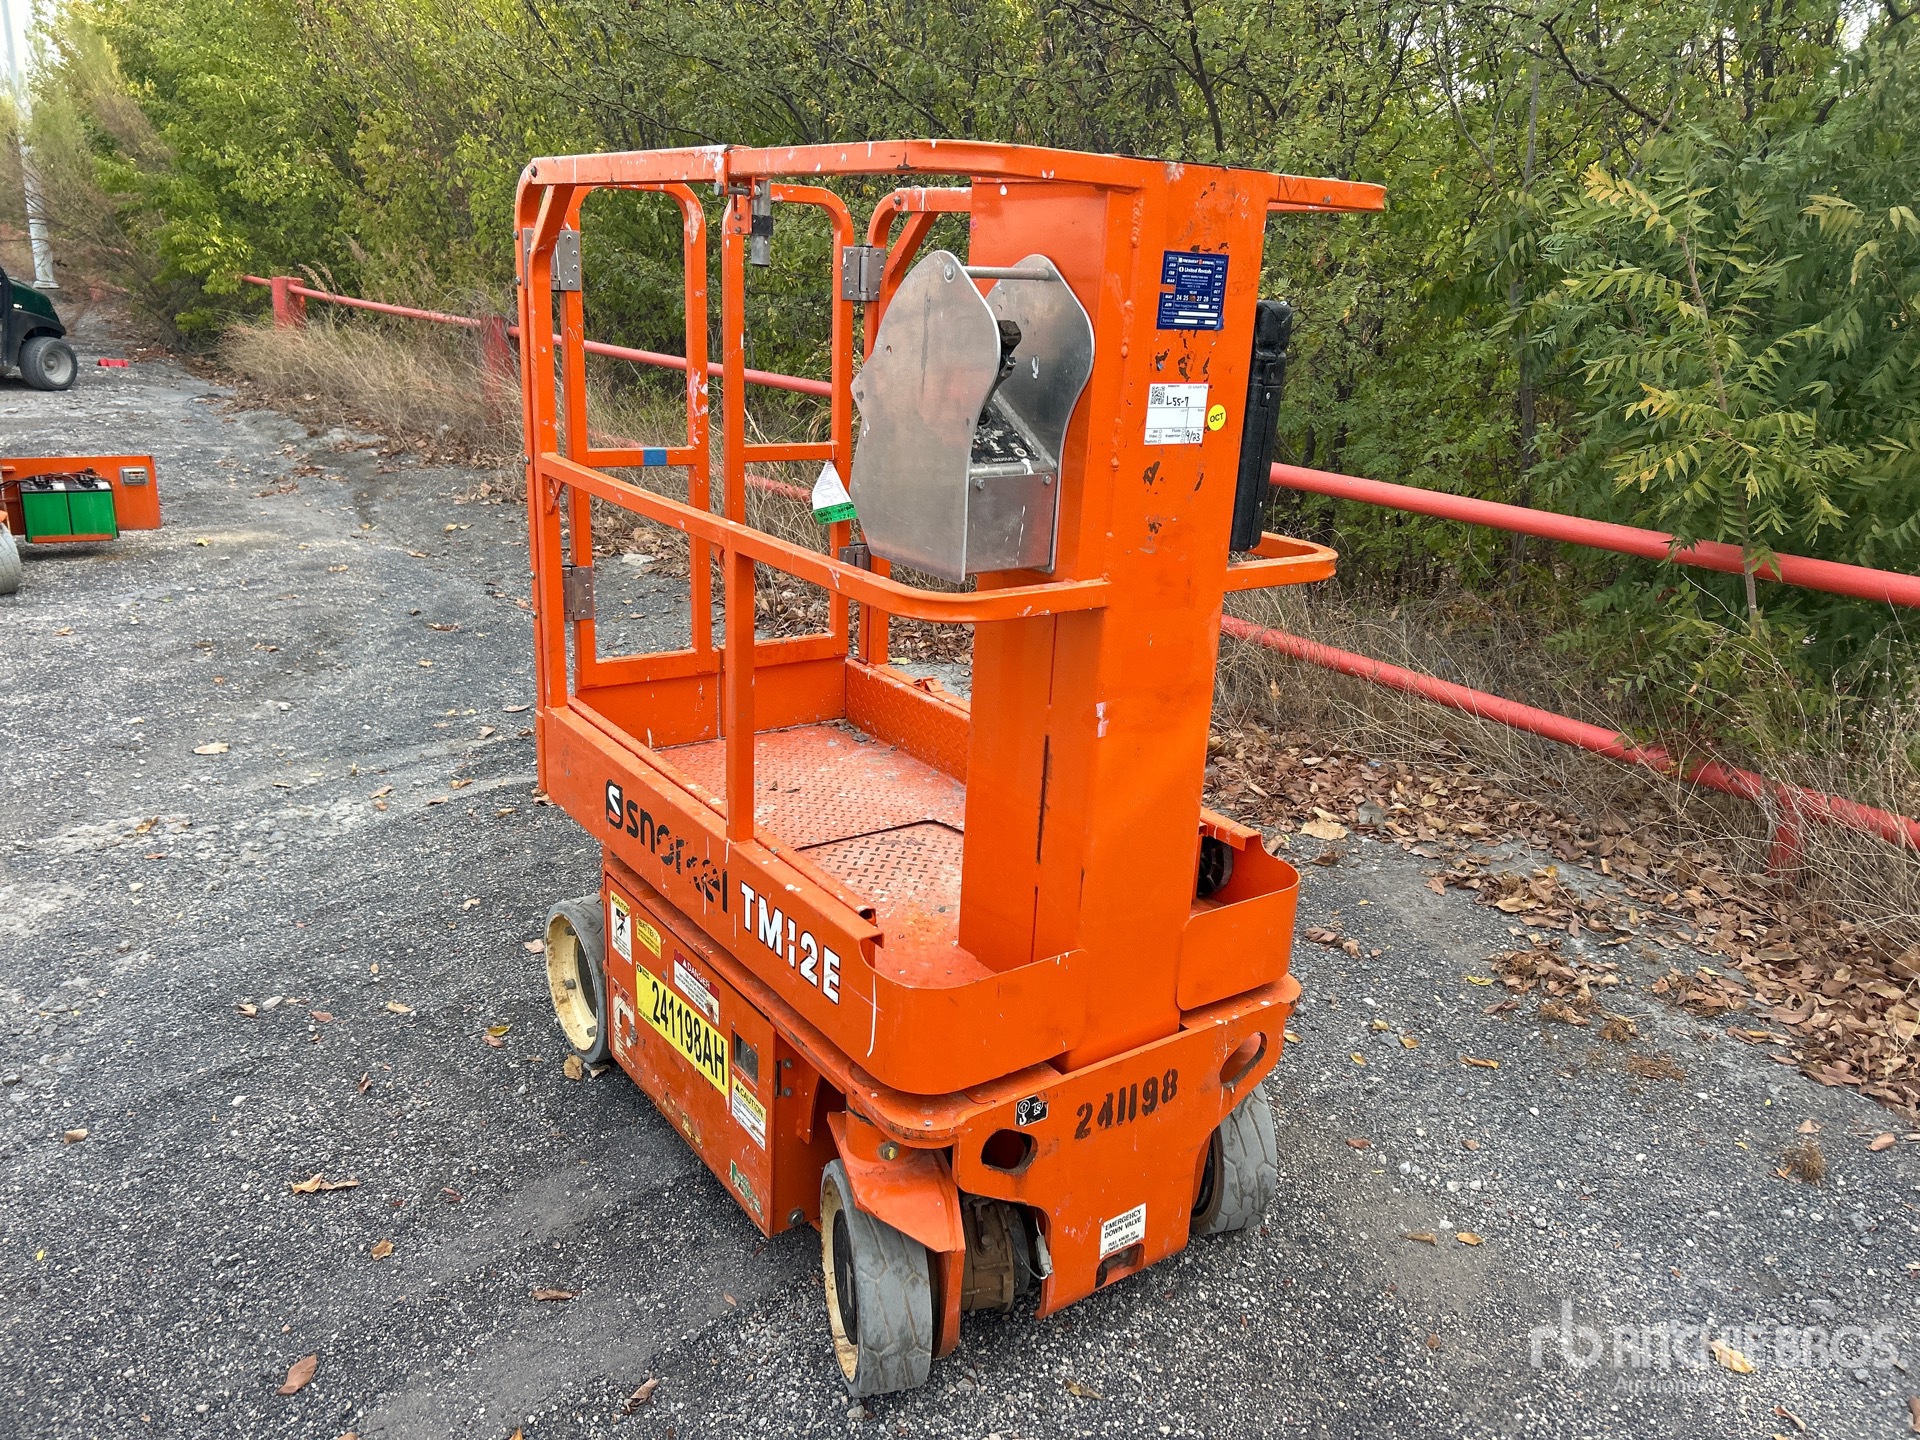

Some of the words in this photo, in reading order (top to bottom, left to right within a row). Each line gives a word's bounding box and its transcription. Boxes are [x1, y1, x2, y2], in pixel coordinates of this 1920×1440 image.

[1166, 396, 1189, 407] L55-7
[1210, 412, 1224, 422] OCT
[626, 800, 728, 913] snorel
[740, 880, 841, 1005] TM12E
[687, 962, 710, 990] DANGER
[652, 980, 726, 1086] 241198AH
[739, 1088, 764, 1118] CAUTION
[1074, 1068, 1179, 1140] 241198
[1104, 1225, 1123, 1239] DOWN
[1125, 1216, 1142, 1229] VALVE
[1105, 1208, 1142, 1231] EMERGENCY
